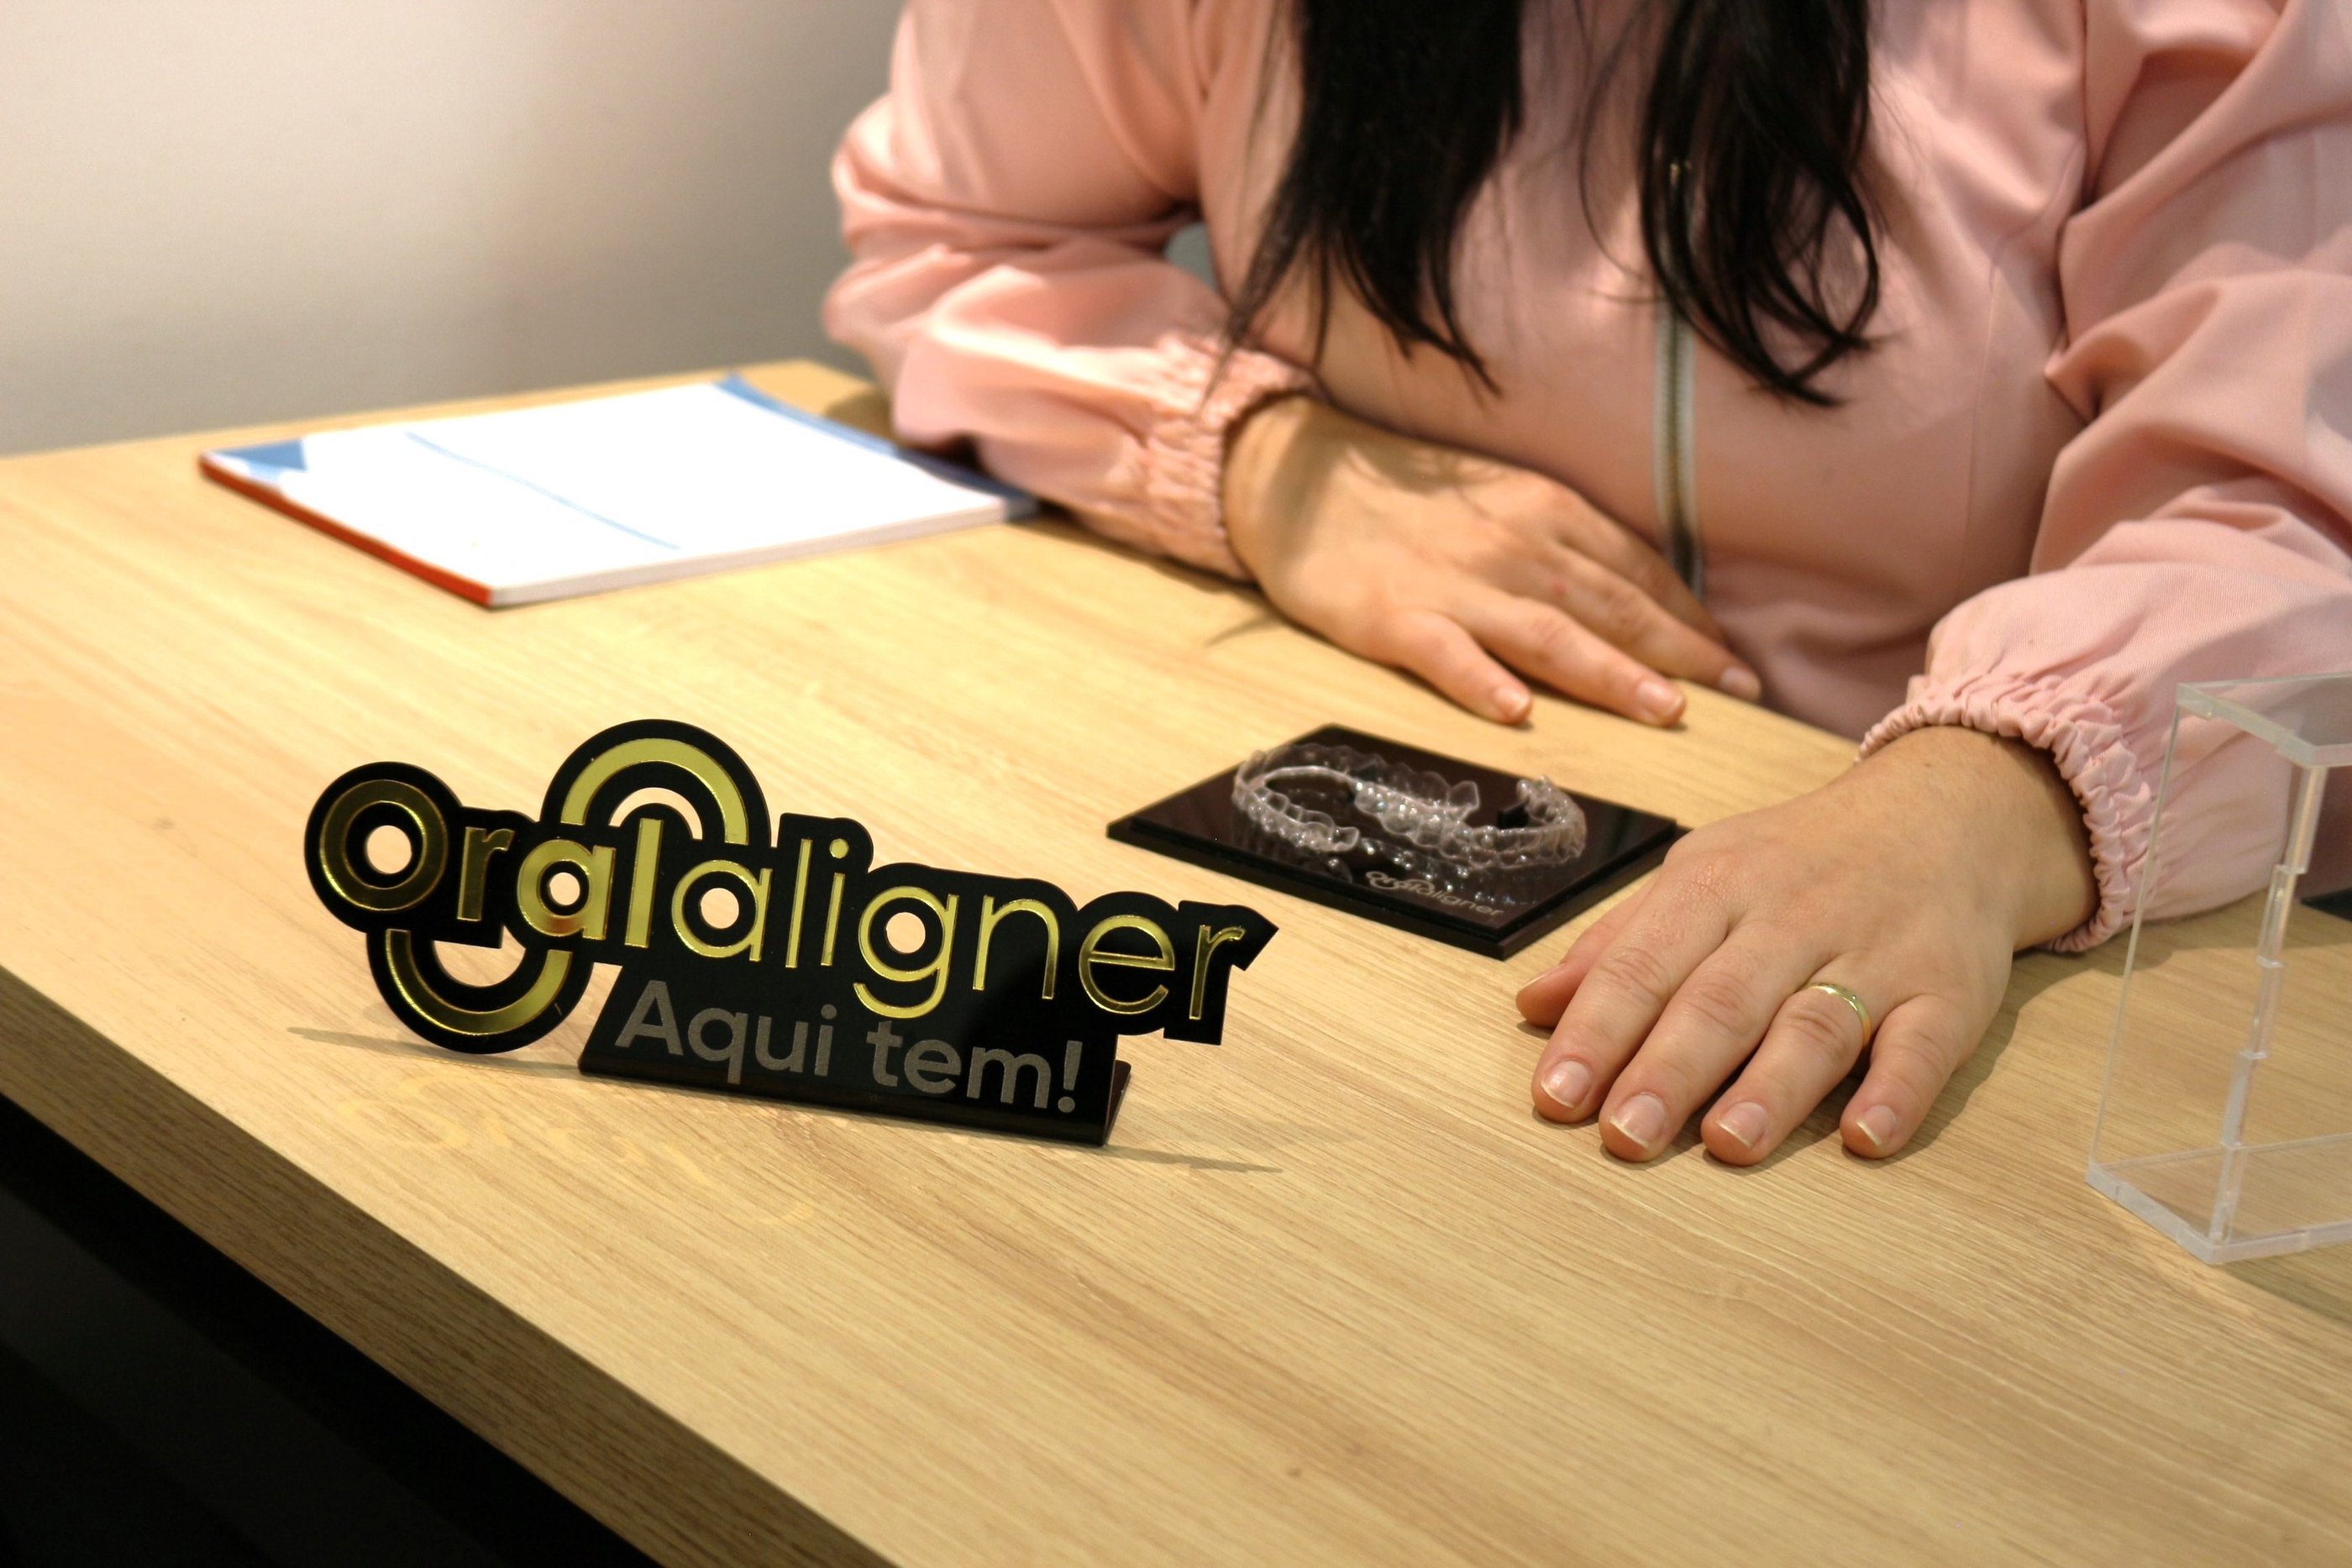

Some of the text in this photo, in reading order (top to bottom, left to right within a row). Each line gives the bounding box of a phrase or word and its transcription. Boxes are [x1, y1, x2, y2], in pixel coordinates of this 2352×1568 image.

[318, 776, 1247, 1021] oralaligner
[614, 980, 1081, 1113] Aqui tem!
